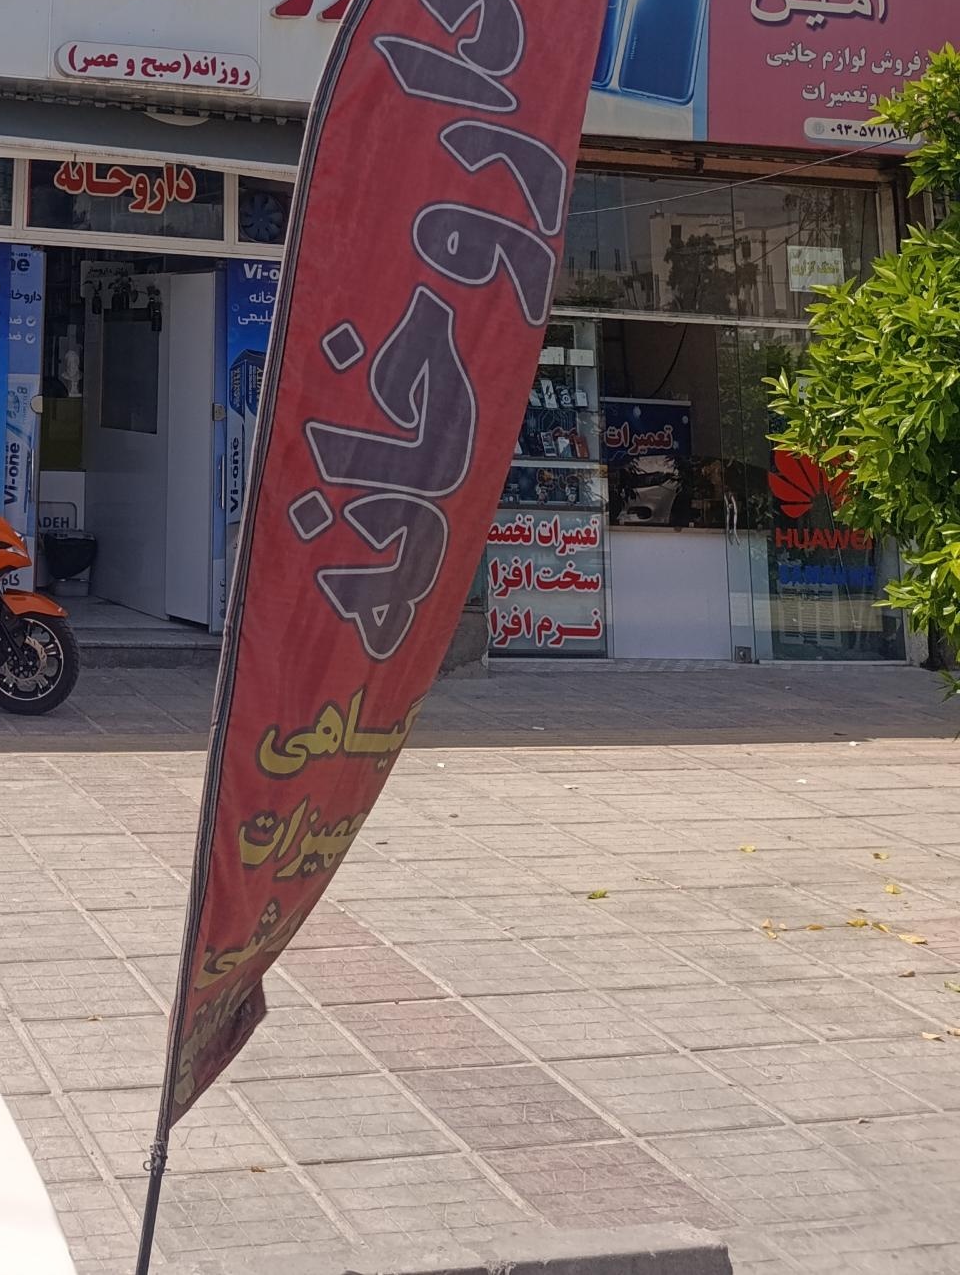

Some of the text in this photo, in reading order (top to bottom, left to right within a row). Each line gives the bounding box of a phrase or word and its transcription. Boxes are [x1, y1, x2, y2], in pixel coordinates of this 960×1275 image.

[125, 58, 135, 76] و
[766, 42, 817, 67] جانبی
[822, 47, 867, 73] لوازم
[871, 50, 922, 77] فروش
[243, 262, 280, 280] Vi-o
[603, 421, 674, 456] تعمیرات
[4, 442, 20, 504] Vi-one
[230, 437, 240, 514] Vi-one
[38, 516, 70, 528] DEH
[487, 513, 600, 556] تعمیرات تخصص
[535, 560, 602, 592] سخت
